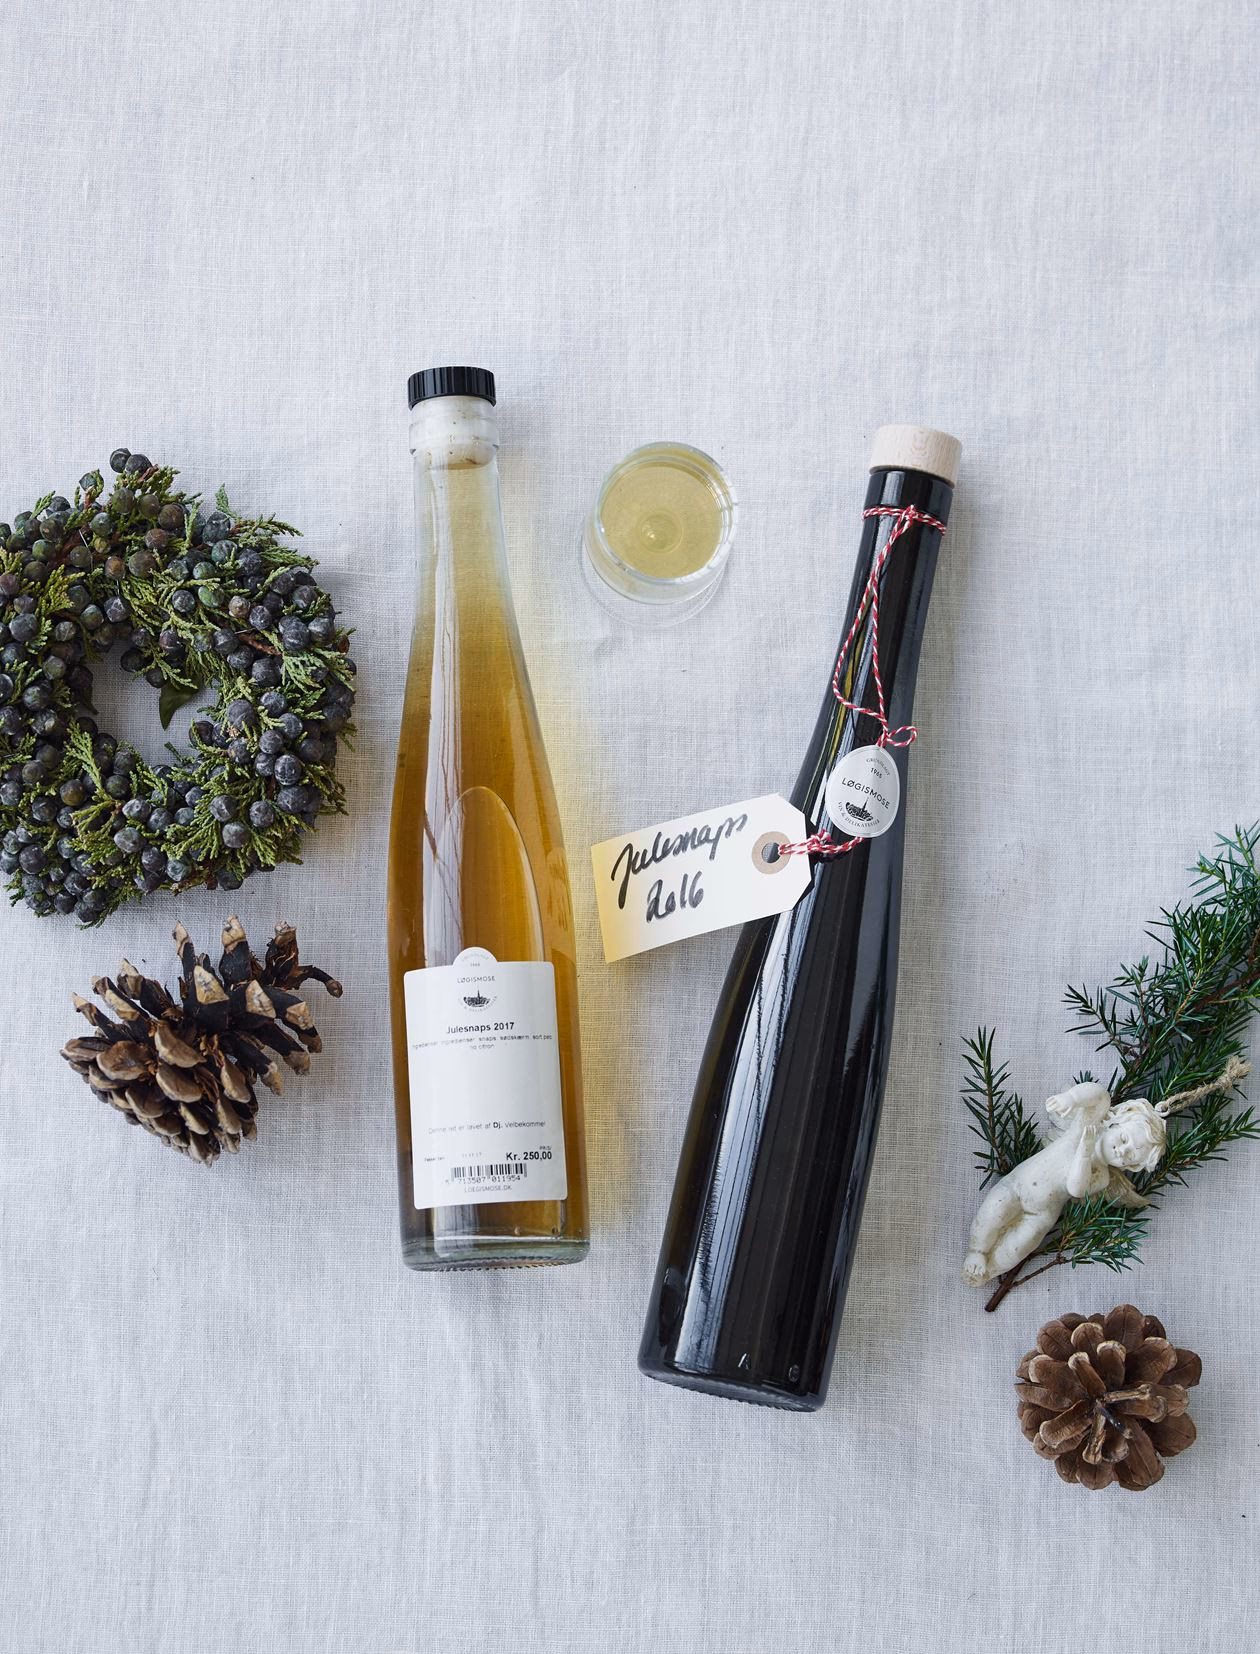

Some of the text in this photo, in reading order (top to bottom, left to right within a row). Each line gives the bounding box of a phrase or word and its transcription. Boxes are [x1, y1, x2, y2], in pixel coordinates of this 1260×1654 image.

[841, 777, 890, 809] LØGISMOSE
[611, 813, 748, 910] Julesnaps
[457, 975, 496, 983] LØGISMOSE
[446, 1021, 515, 1034] Julesnaps 2017
[506, 1150, 553, 1162] Kr. 250,00
